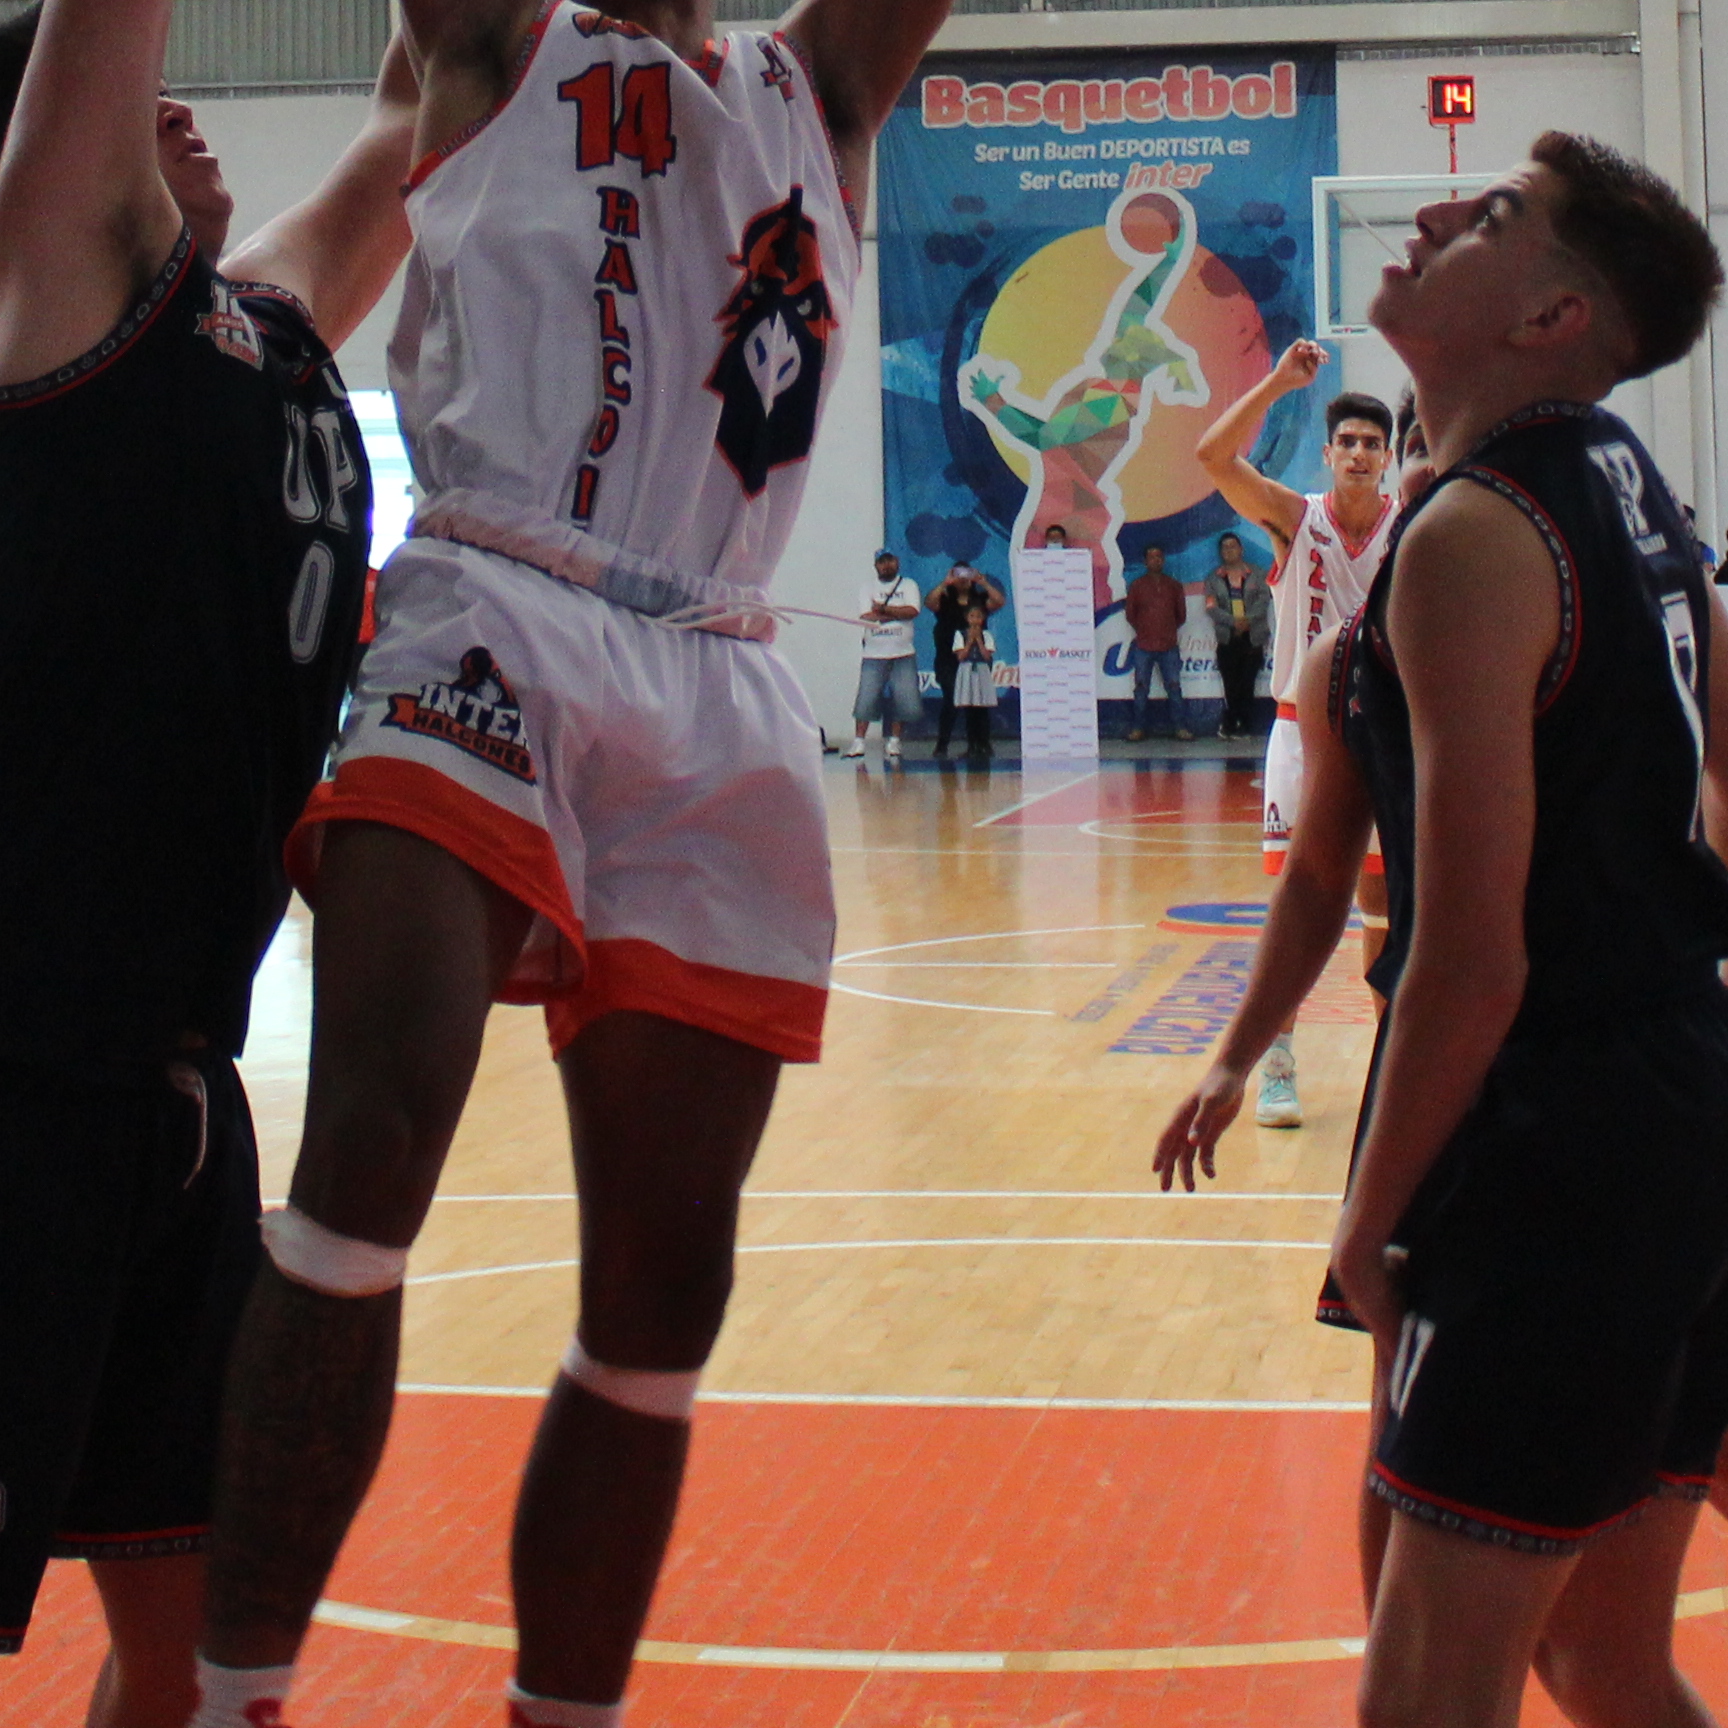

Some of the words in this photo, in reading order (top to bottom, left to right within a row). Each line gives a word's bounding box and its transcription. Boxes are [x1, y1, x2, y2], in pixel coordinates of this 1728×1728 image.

[557, 61, 677, 179] 14
[922, 62, 1296, 133] Basquetbol
[1444, 84, 1472, 113] 14
[974, 143, 1010, 163] Ser
[1012, 144, 1040, 162] un
[1044, 141, 1096, 161] Buen
[1100, 136, 1225, 159] DEPORTISTA
[1227, 139, 1251, 156] es
[1019, 171, 1052, 191] Ser
[1059, 169, 1120, 189] Gente
[282, 401, 356, 534] UP
[412, 713, 530, 772] HALCONES
